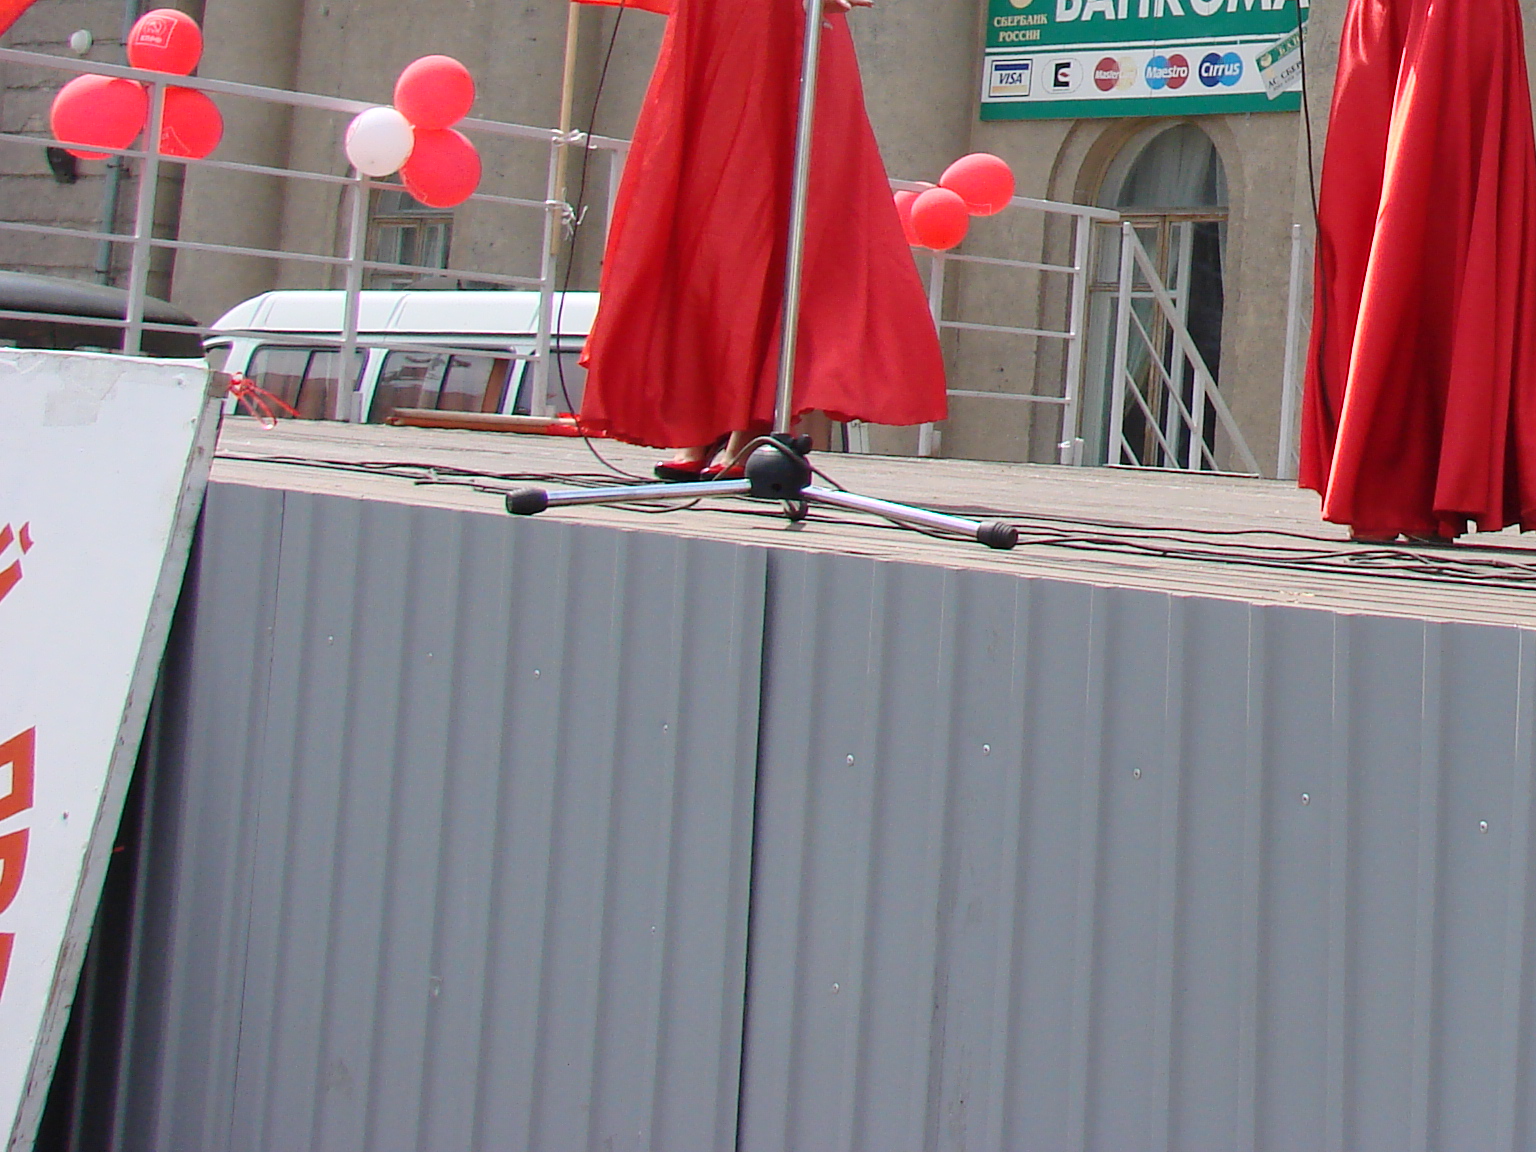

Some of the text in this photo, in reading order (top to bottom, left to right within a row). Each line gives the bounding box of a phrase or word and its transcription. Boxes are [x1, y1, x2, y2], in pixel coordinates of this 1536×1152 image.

[993, 14, 1048, 28] СБЕРБАНК
[998, 29, 1040, 42] РОССИИ
[1146, 64, 1187, 78] Maestro
[1201, 62, 1240, 77] Cirrus
[999, 72, 1023, 85] VISA
